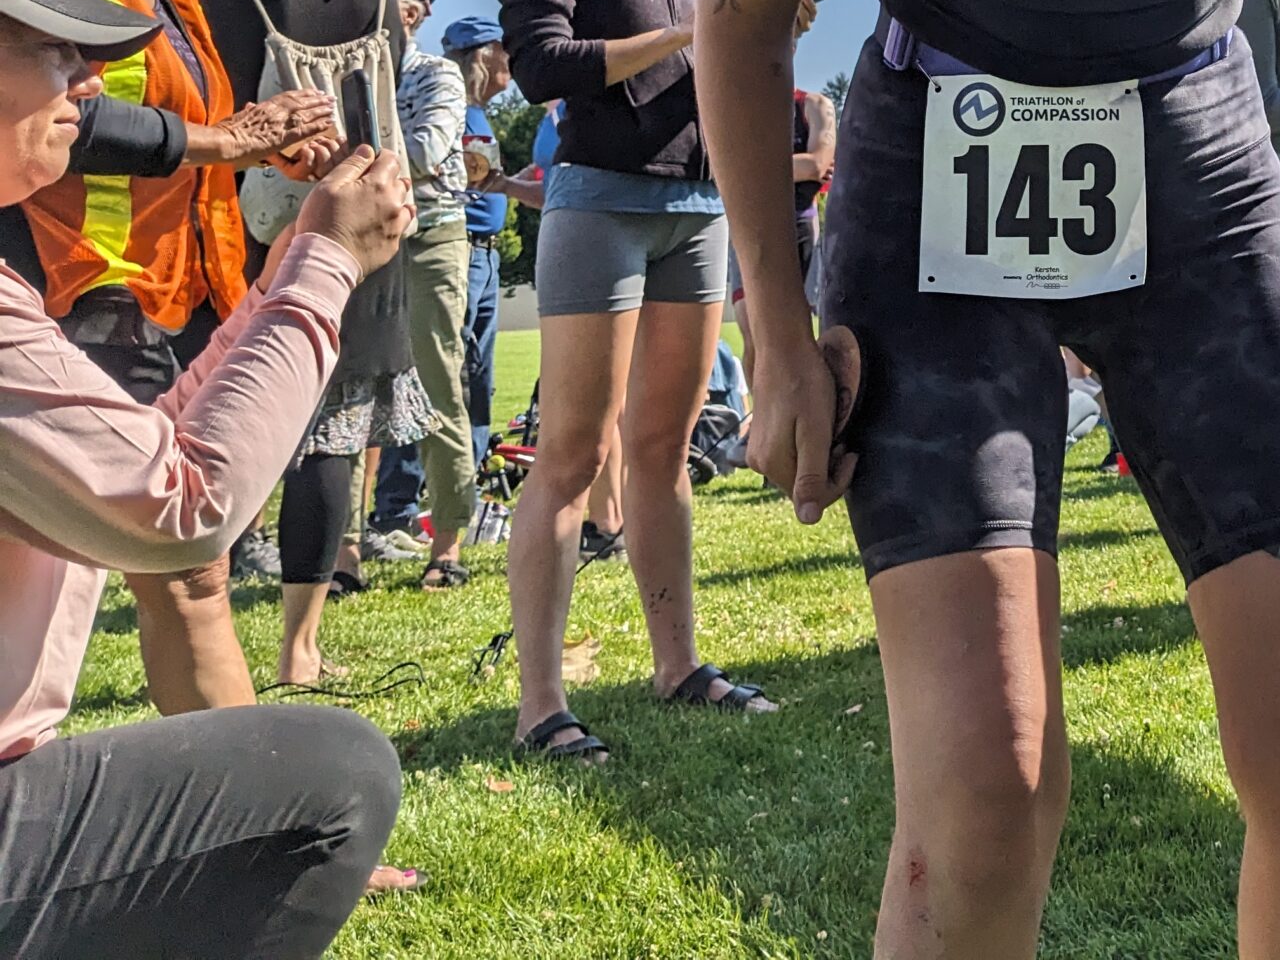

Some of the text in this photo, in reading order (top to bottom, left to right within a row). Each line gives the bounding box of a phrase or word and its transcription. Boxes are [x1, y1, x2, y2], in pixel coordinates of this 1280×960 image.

[1010, 96, 1085, 106] TRIATHLON of
[1010, 108, 1120, 121] COMPASSION
[953, 143, 1116, 256] 143
